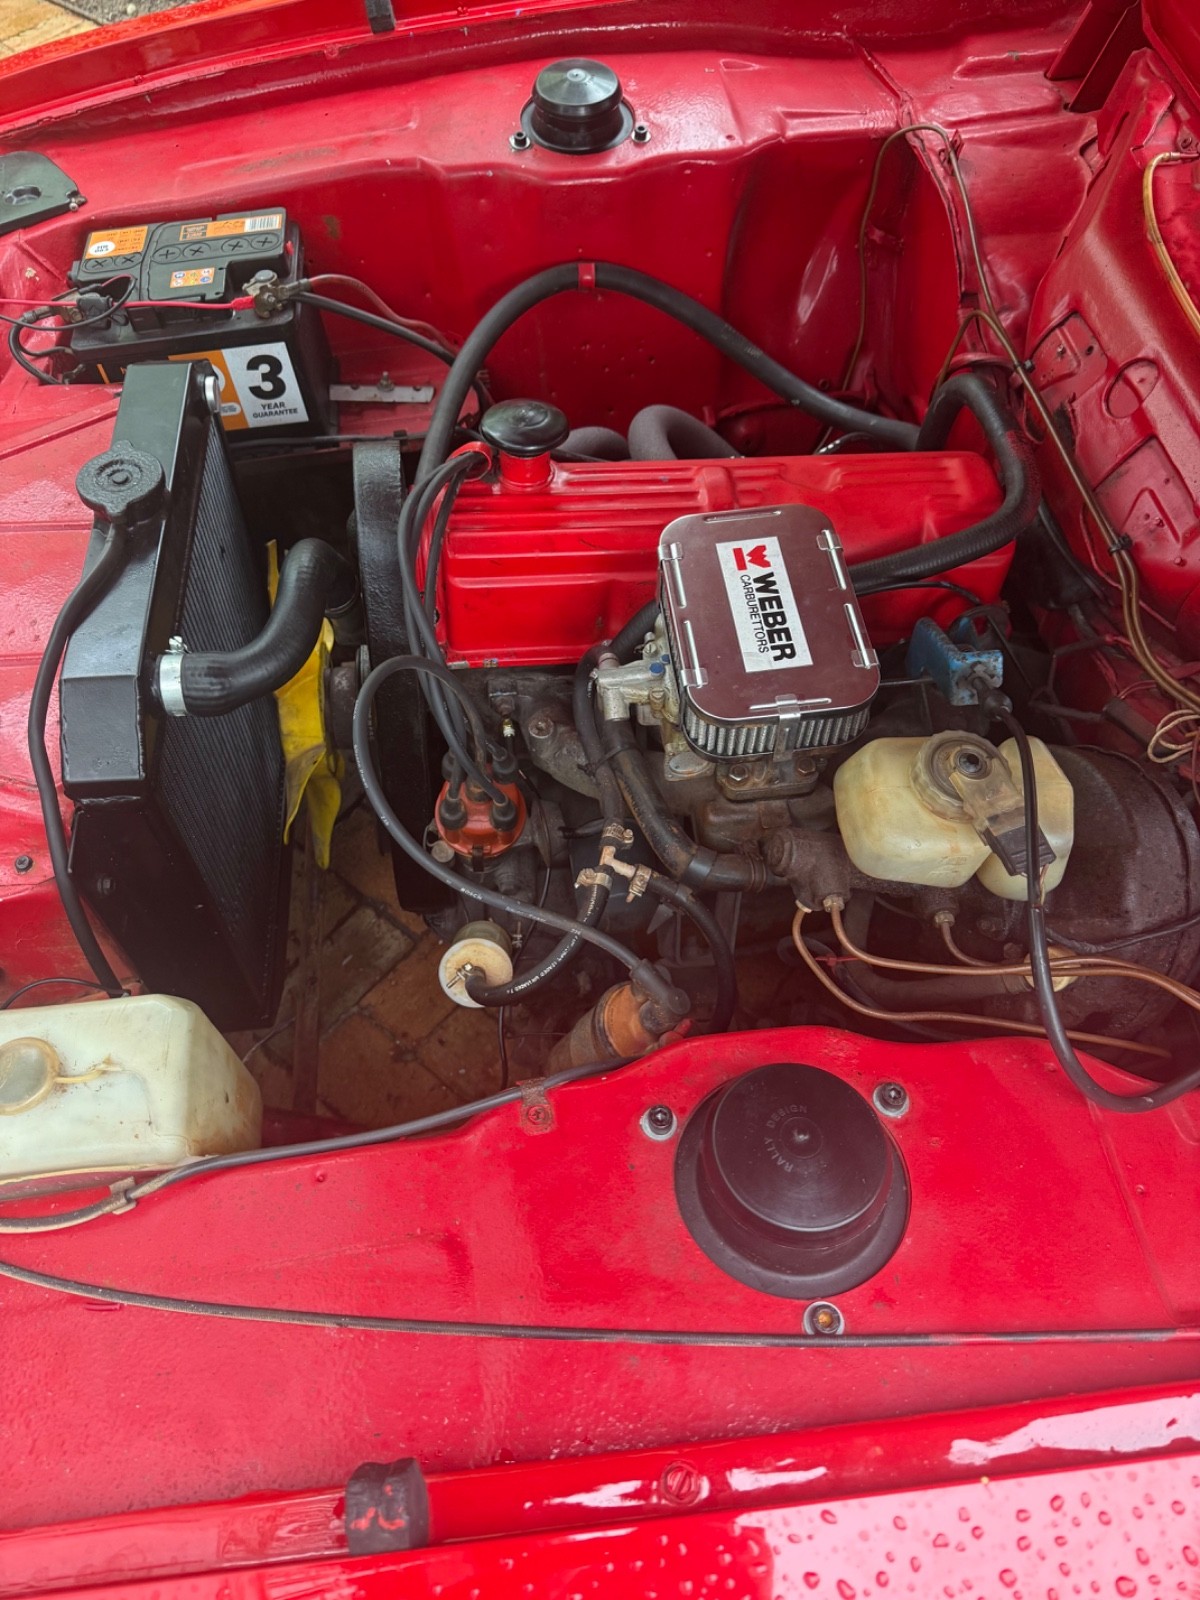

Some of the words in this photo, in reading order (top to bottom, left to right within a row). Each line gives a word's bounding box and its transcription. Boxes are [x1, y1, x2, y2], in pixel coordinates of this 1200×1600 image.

[246, 354, 287, 400] 3
[252, 408, 299, 419] GUARANTEE
[260, 402, 286, 410] YEAR
[739, 574, 769, 654] CARBURETTORS
[753, 571, 797, 662] WEBER
[766, 1105, 808, 1128] DESIGN
[764, 1137, 794, 1173] RALLY
